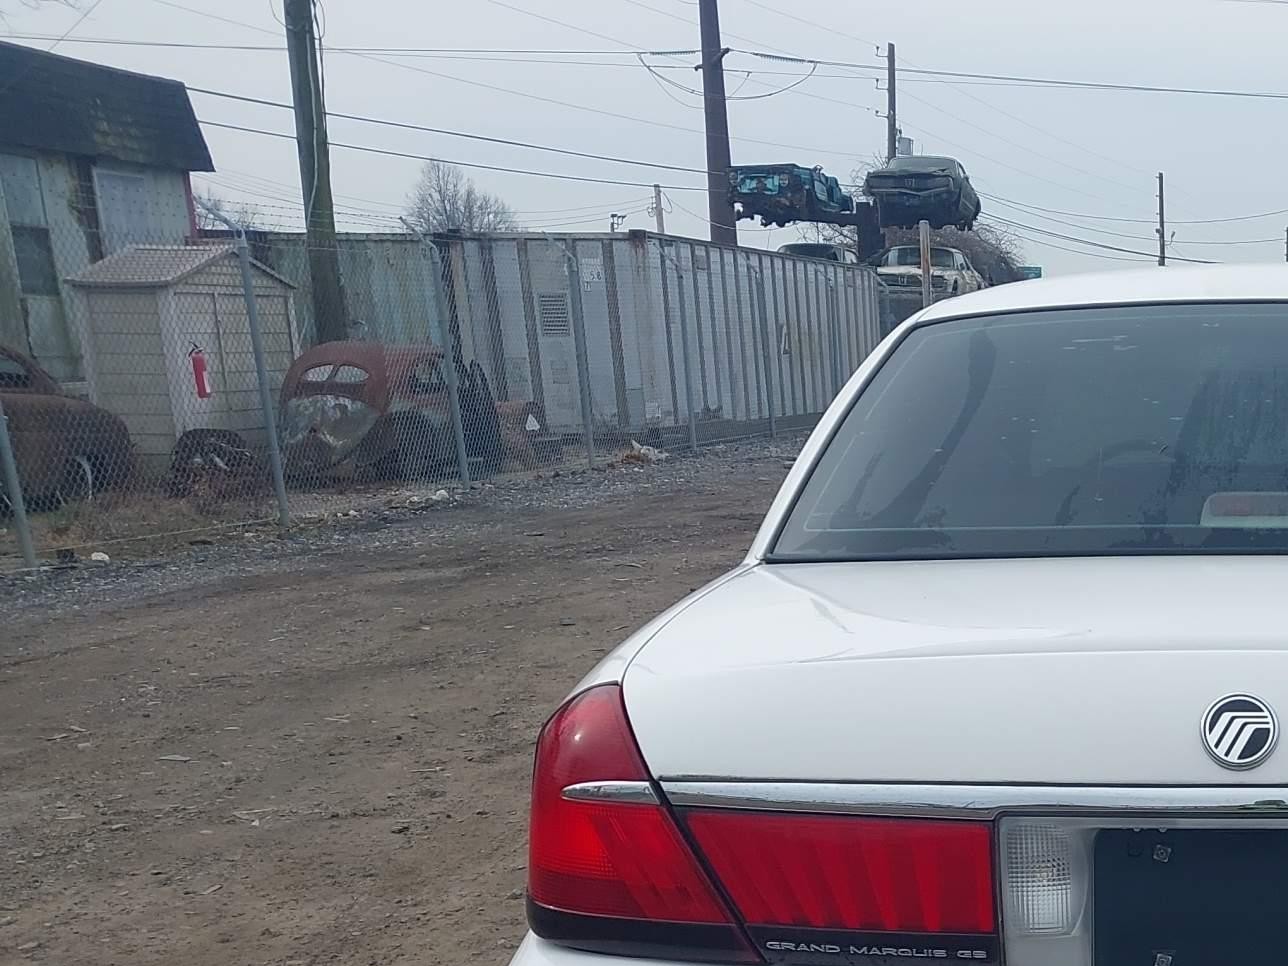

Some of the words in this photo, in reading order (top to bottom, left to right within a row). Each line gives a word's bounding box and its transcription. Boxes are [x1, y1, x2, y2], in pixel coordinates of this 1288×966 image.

[766, 941, 841, 953] GRAND
[850, 946, 947, 957] MARQUIS
[956, 950, 987, 959] GS
